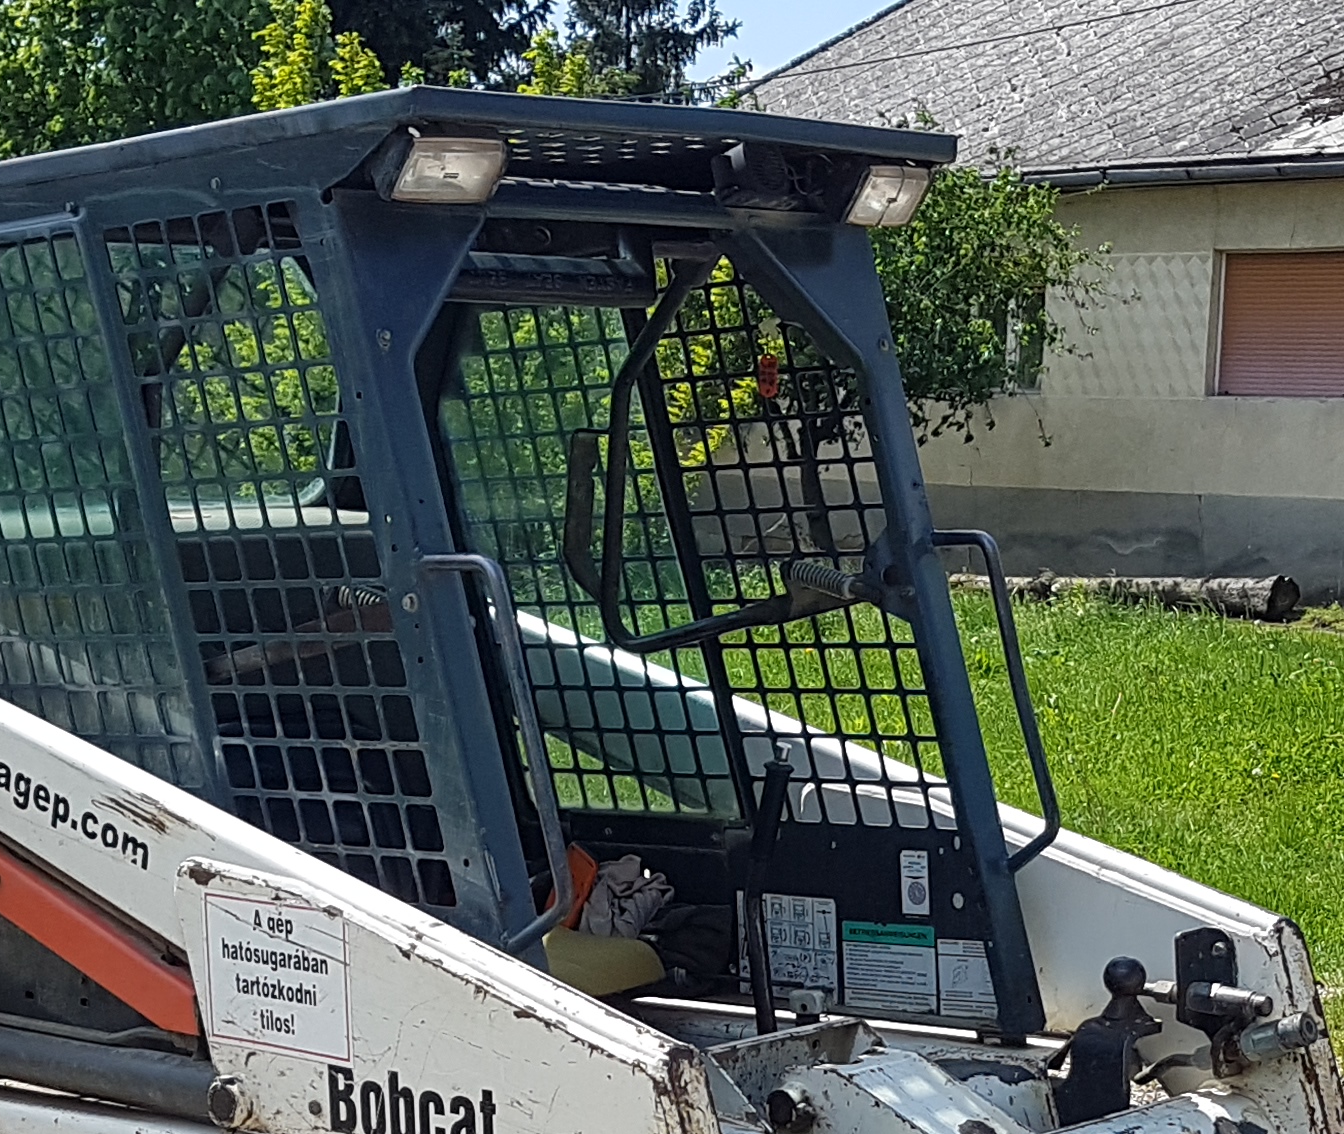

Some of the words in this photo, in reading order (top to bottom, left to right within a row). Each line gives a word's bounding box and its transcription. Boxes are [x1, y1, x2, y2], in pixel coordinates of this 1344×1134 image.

[253, 909, 262, 929] A
[267, 914, 294, 937] gép
[222, 938, 329, 975] hatósugarában
[236, 973, 317, 1006] tartózkodni
[260, 1009, 296, 1035] tilos!
